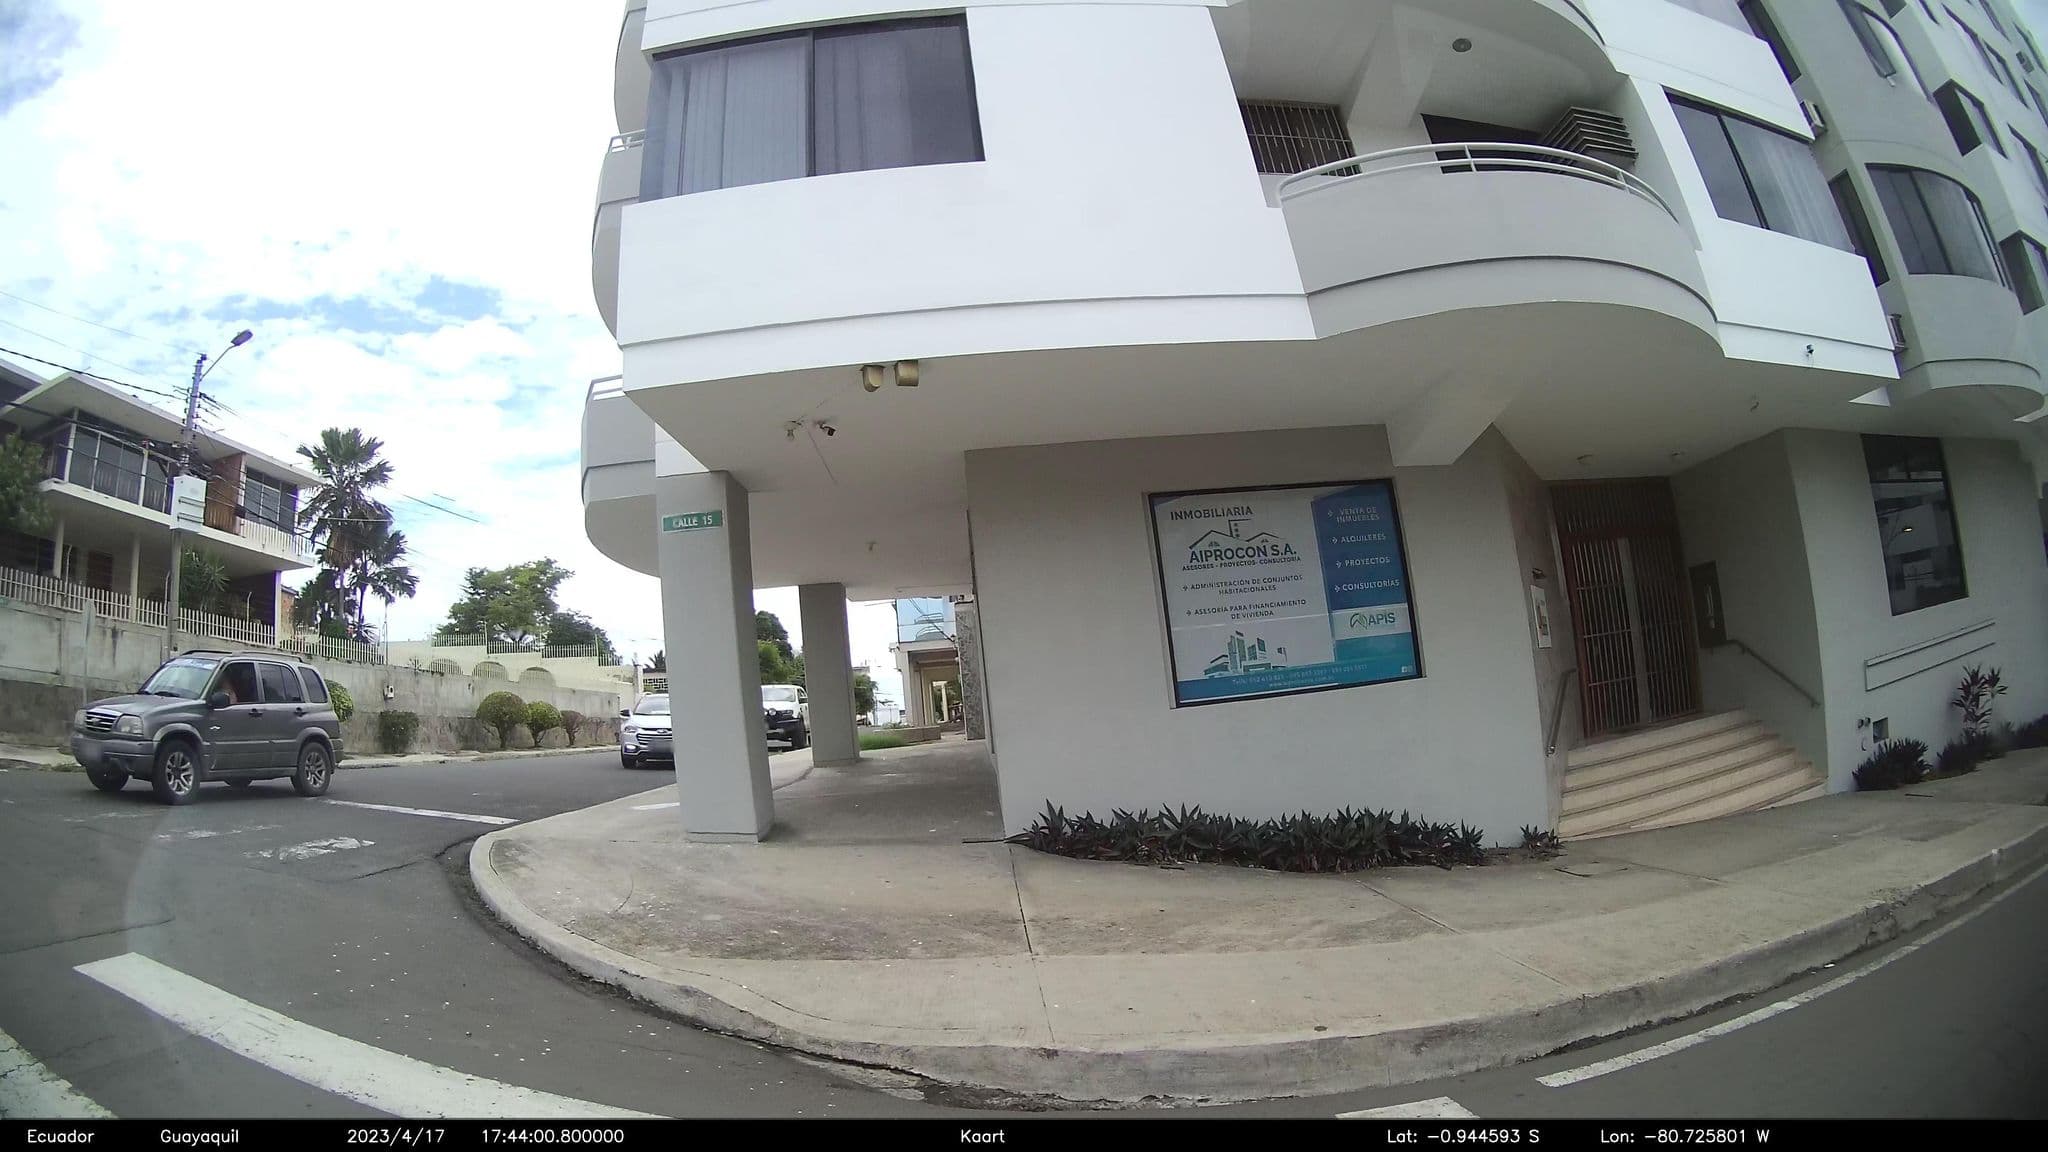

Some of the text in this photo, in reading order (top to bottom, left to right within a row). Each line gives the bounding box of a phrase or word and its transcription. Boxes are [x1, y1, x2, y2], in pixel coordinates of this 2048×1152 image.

[1170, 506, 1253, 520] INMOBILIARIA
[1340, 507, 1364, 515] VENTA
[672, 515, 713, 528] CALLE 15
[1336, 514, 1380, 522] INMUEBLES
[1340, 533, 1386, 543] ALQUILERES
[1189, 543, 1297, 563] AIPROCON S.A.
[1344, 556, 1391, 566] PROYECTOS
[1182, 563, 1214, 571] ASESORES
[1262, 574, 1303, 584] CONJUNTOS
[1219, 585, 1277, 595] HABITACIONALES
[1249, 599, 1306, 610] FINANCIAMIENTO
[1242, 610, 1274, 618] VIVIENDA
[1368, 612, 1396, 626] APIS
